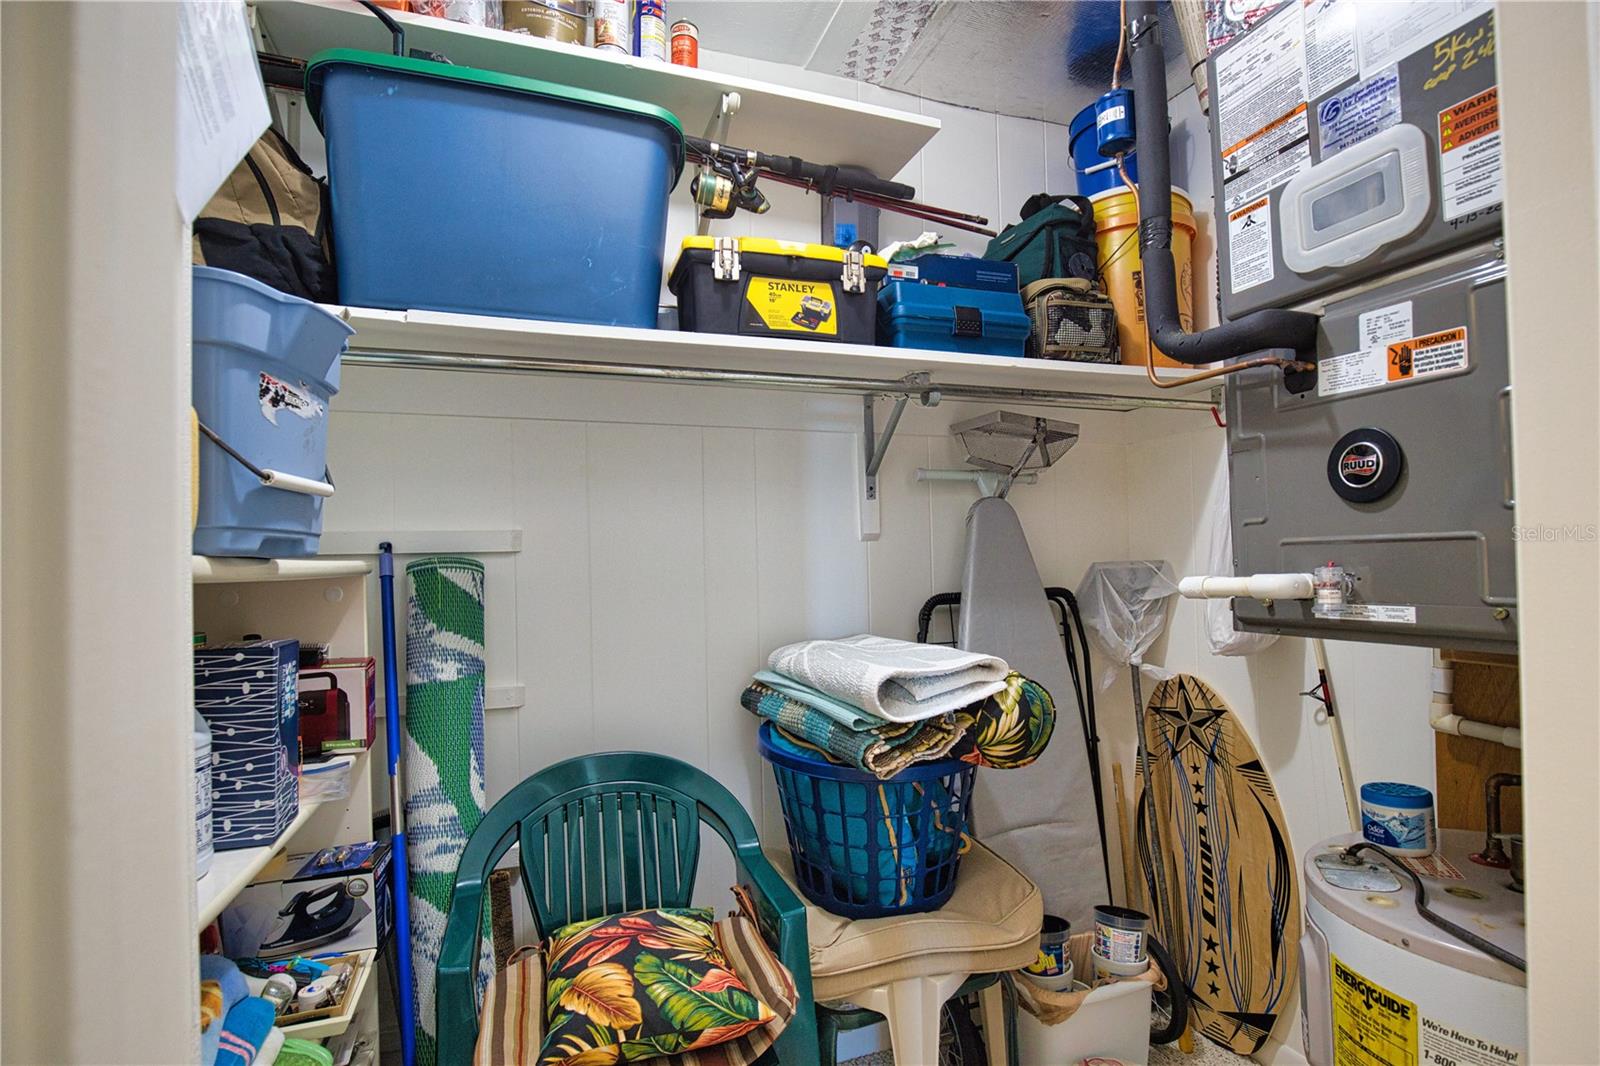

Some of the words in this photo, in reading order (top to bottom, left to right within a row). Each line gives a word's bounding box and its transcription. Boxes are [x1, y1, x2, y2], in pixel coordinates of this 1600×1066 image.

[768, 282, 815, 293] STANLEY
[1344, 459, 1375, 471] RUUD
[1367, 824, 1385, 834] Odor
[1422, 1017, 1449, 1036] We're
[1450, 1030, 1475, 1046] Here
[1476, 1039, 1488, 1051] To
[1489, 1045, 1519, 1062] Help!
